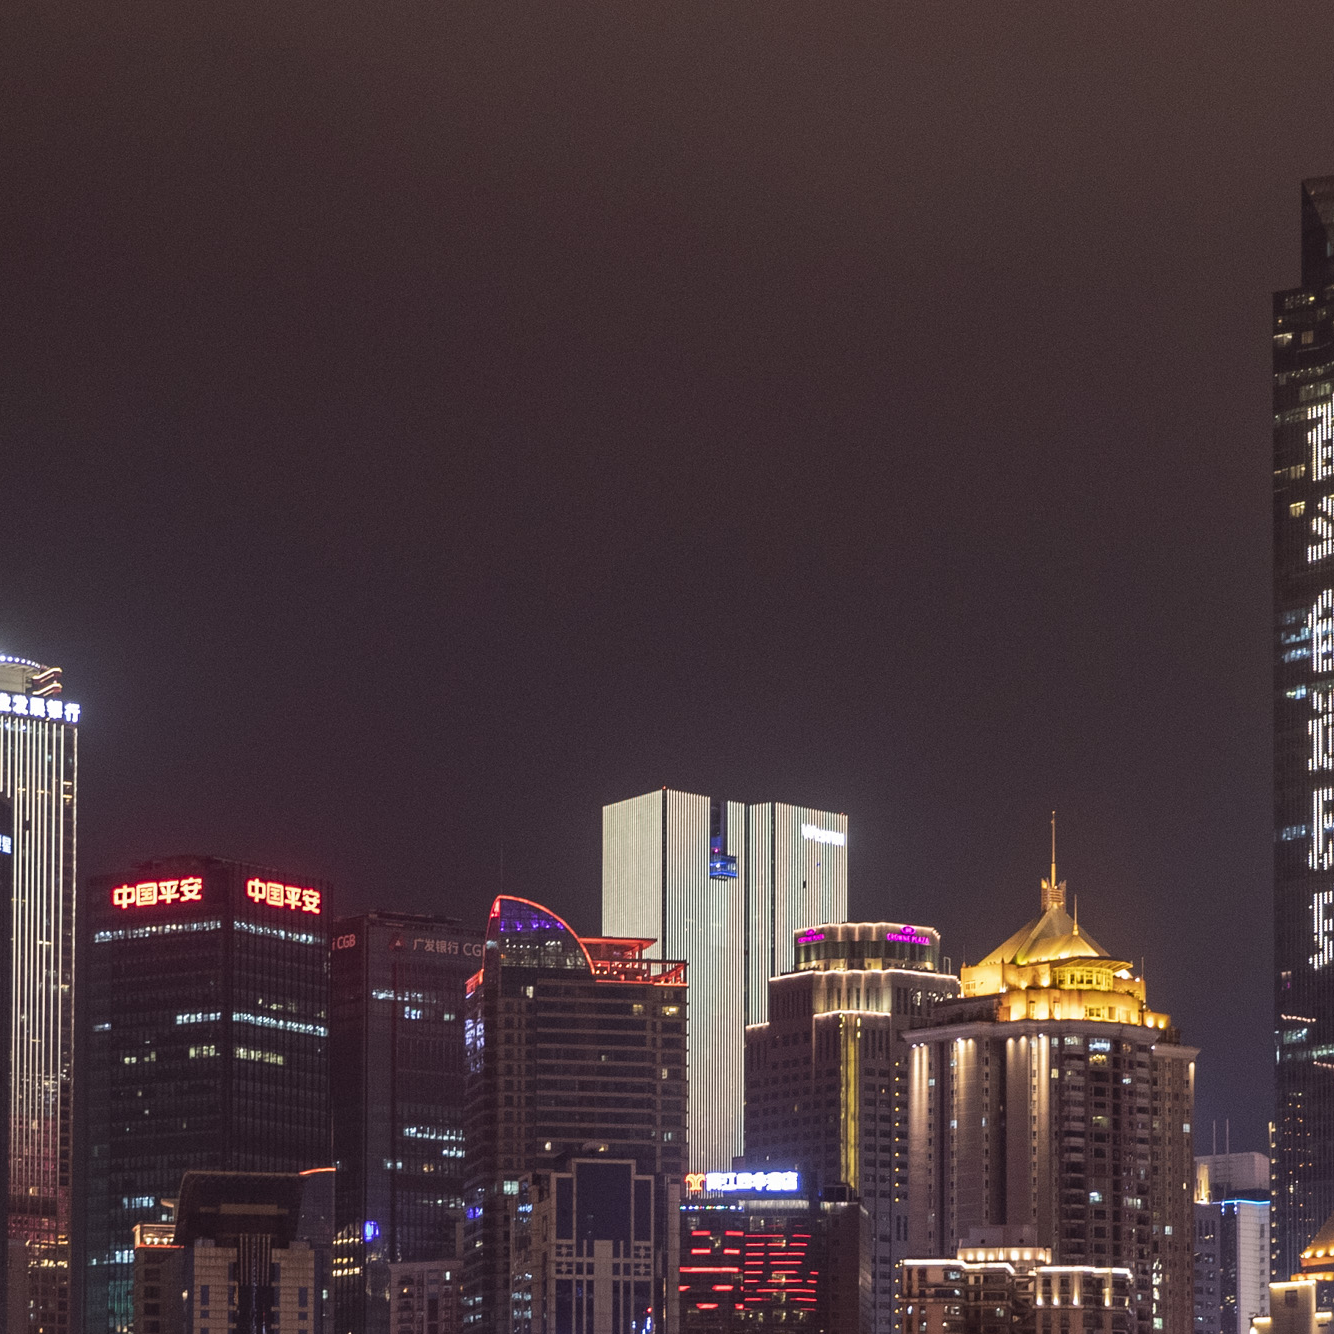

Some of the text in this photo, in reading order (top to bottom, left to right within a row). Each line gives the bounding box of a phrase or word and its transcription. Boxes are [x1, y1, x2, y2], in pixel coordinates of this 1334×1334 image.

[112, 877, 203, 909] 中国平安
[247, 878, 321, 914] 中国平安
[413, 938, 460, 956] 广发银行
